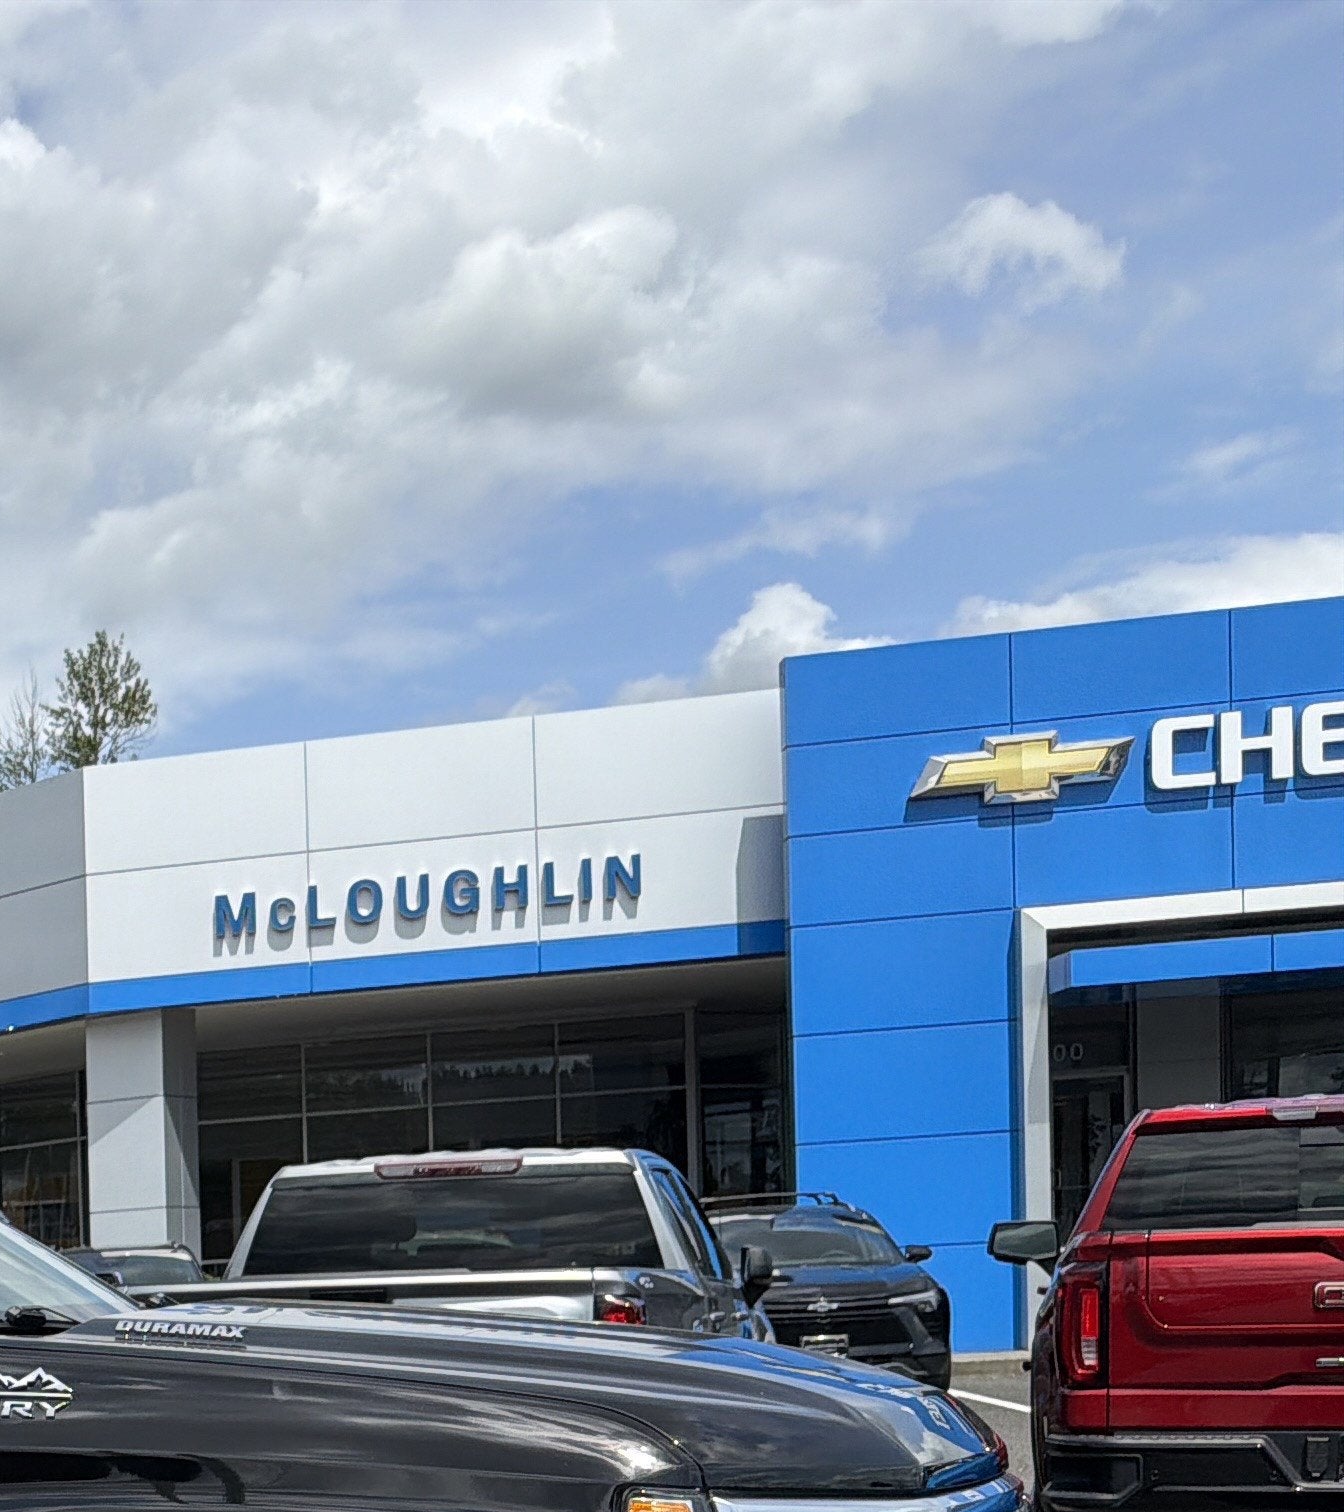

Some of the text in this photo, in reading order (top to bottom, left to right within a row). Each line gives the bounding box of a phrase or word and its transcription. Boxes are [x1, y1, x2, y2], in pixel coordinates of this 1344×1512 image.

[1151, 700, 1344, 790] CHE
[214, 853, 643, 939] McLOUGHLIN
[115, 1320, 247, 1339] DURAMAX
